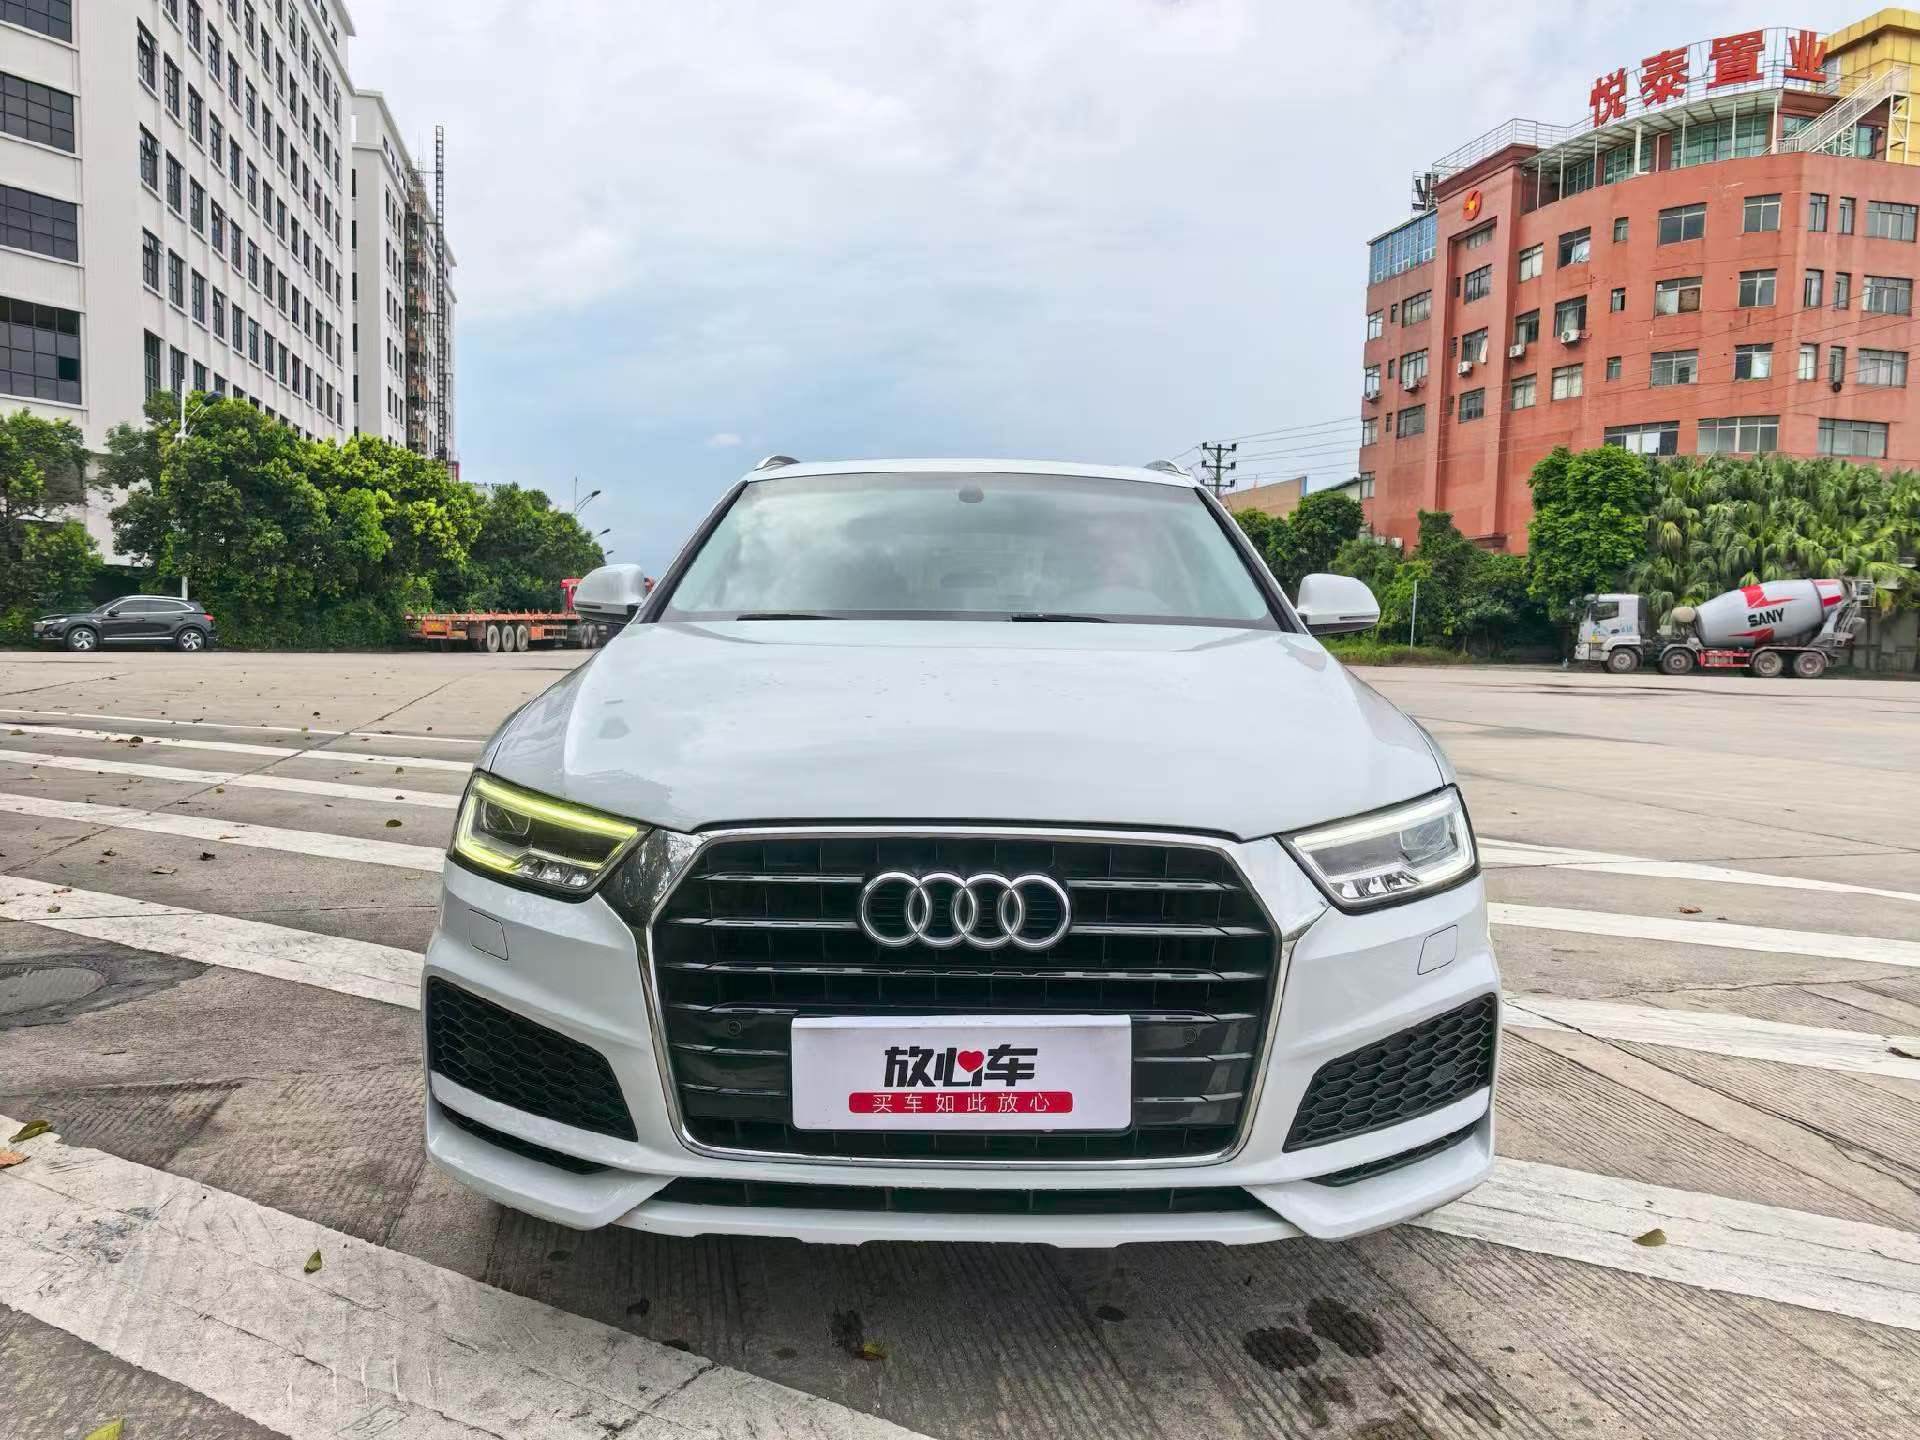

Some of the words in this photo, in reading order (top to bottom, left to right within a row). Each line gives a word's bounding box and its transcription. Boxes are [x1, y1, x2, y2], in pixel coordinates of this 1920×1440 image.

[1590, 30, 1827, 127] 悦泰置业
[1748, 608, 1785, 628] SANY
[884, 1044, 1038, 1087] 放心车
[873, 1094, 1050, 1113] 买车如此放心
